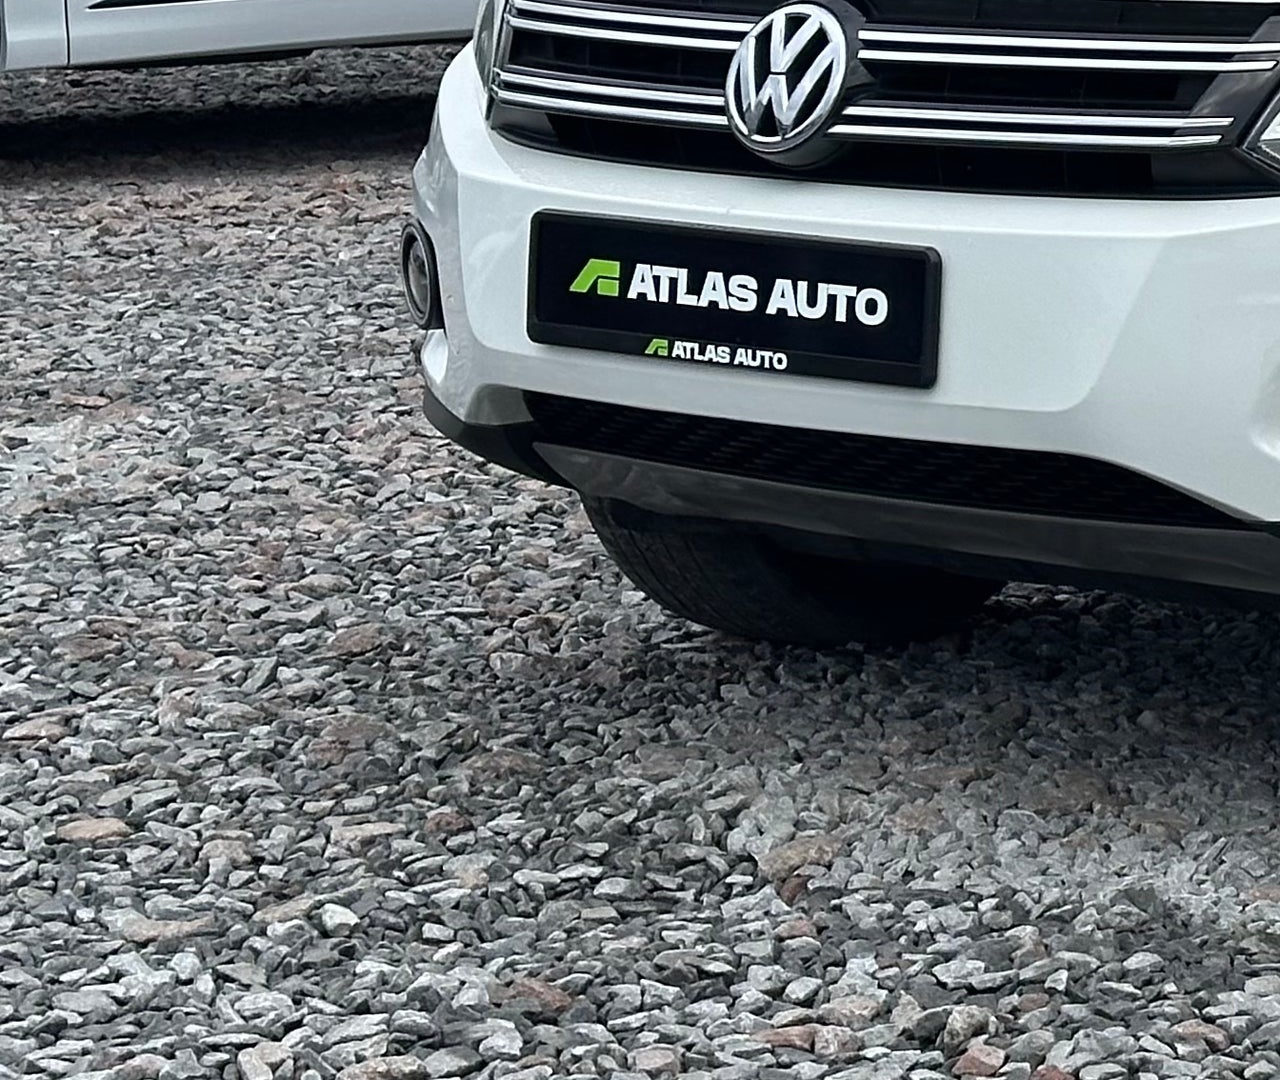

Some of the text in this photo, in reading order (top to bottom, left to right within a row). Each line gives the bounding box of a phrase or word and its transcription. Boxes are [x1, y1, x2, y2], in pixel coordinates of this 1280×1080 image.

[728, 6, 844, 149] VW
[626, 262, 889, 326] ATLAS AUTO
[671, 339, 788, 370] ATLAS AUTO
